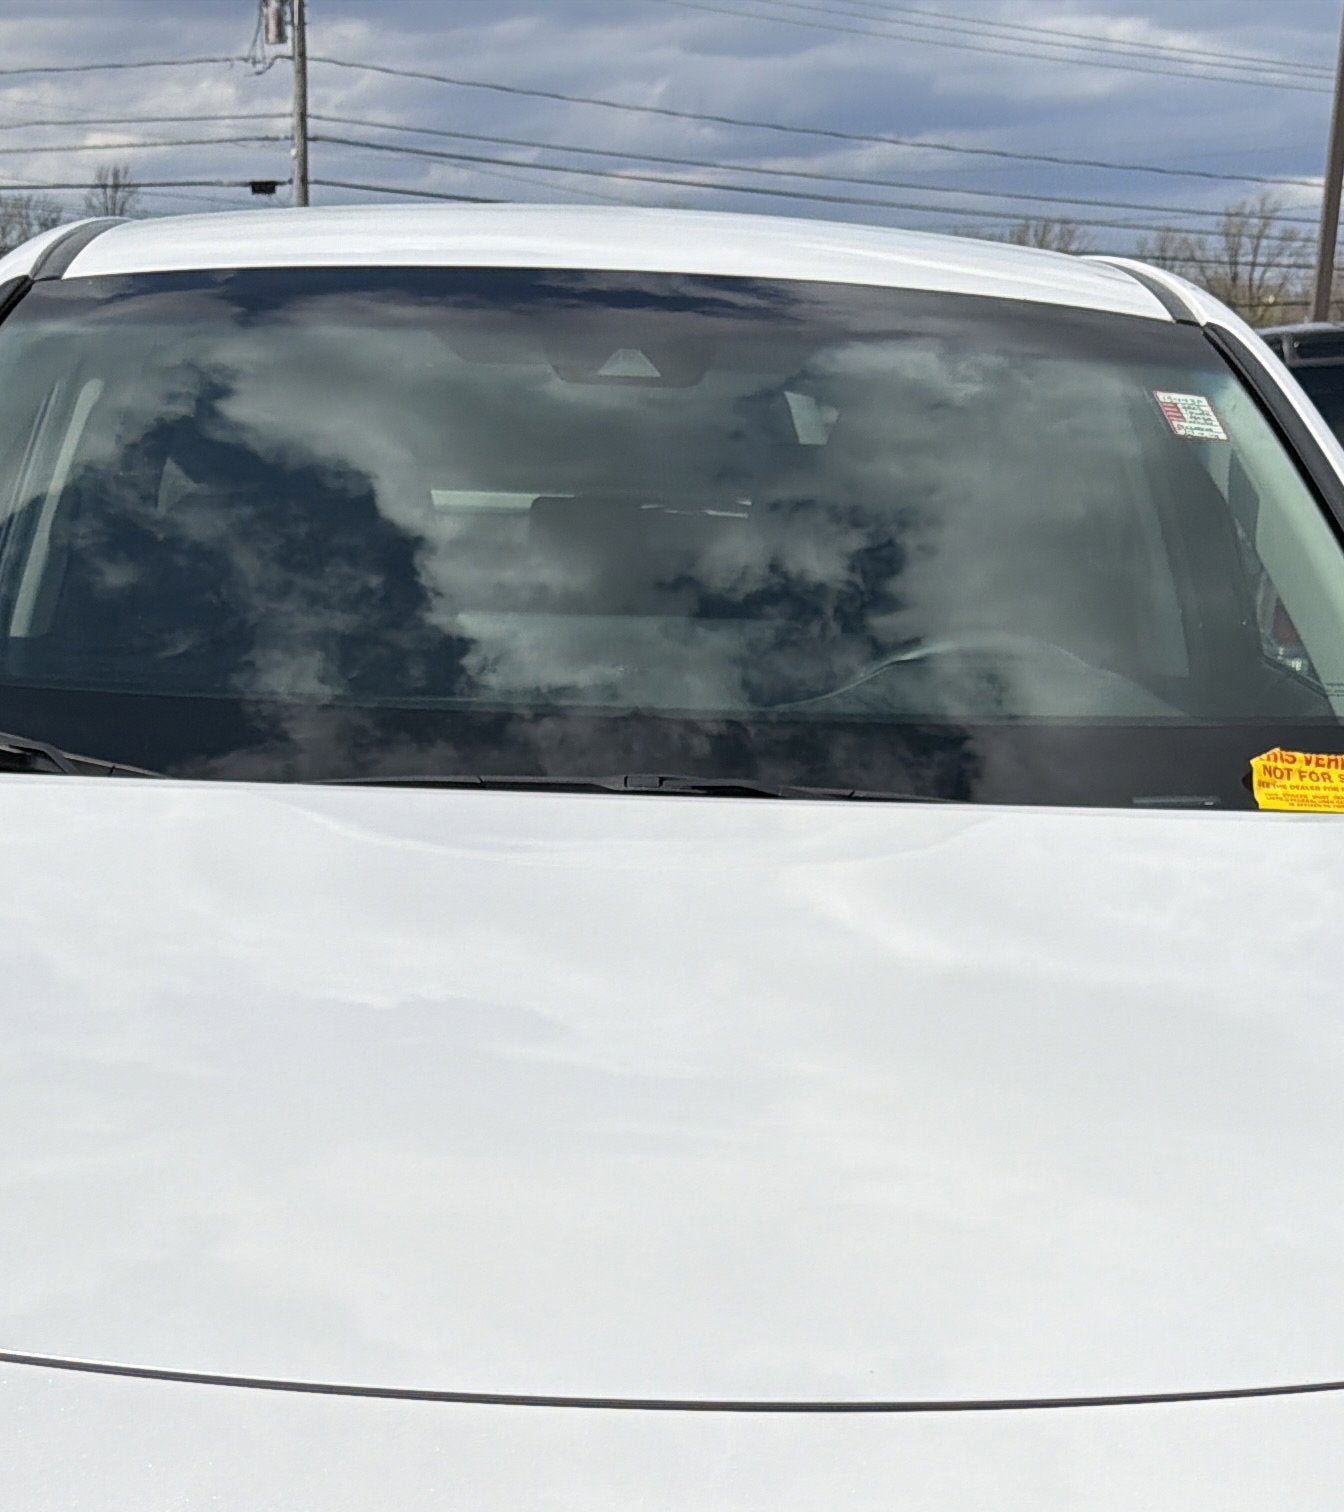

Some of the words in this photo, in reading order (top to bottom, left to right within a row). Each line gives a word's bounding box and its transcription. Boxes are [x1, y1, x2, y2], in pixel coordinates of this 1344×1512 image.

[1259, 751, 1296, 765] HIS
[1262, 764, 1293, 781] NOT
[1297, 768, 1334, 784] FOR
